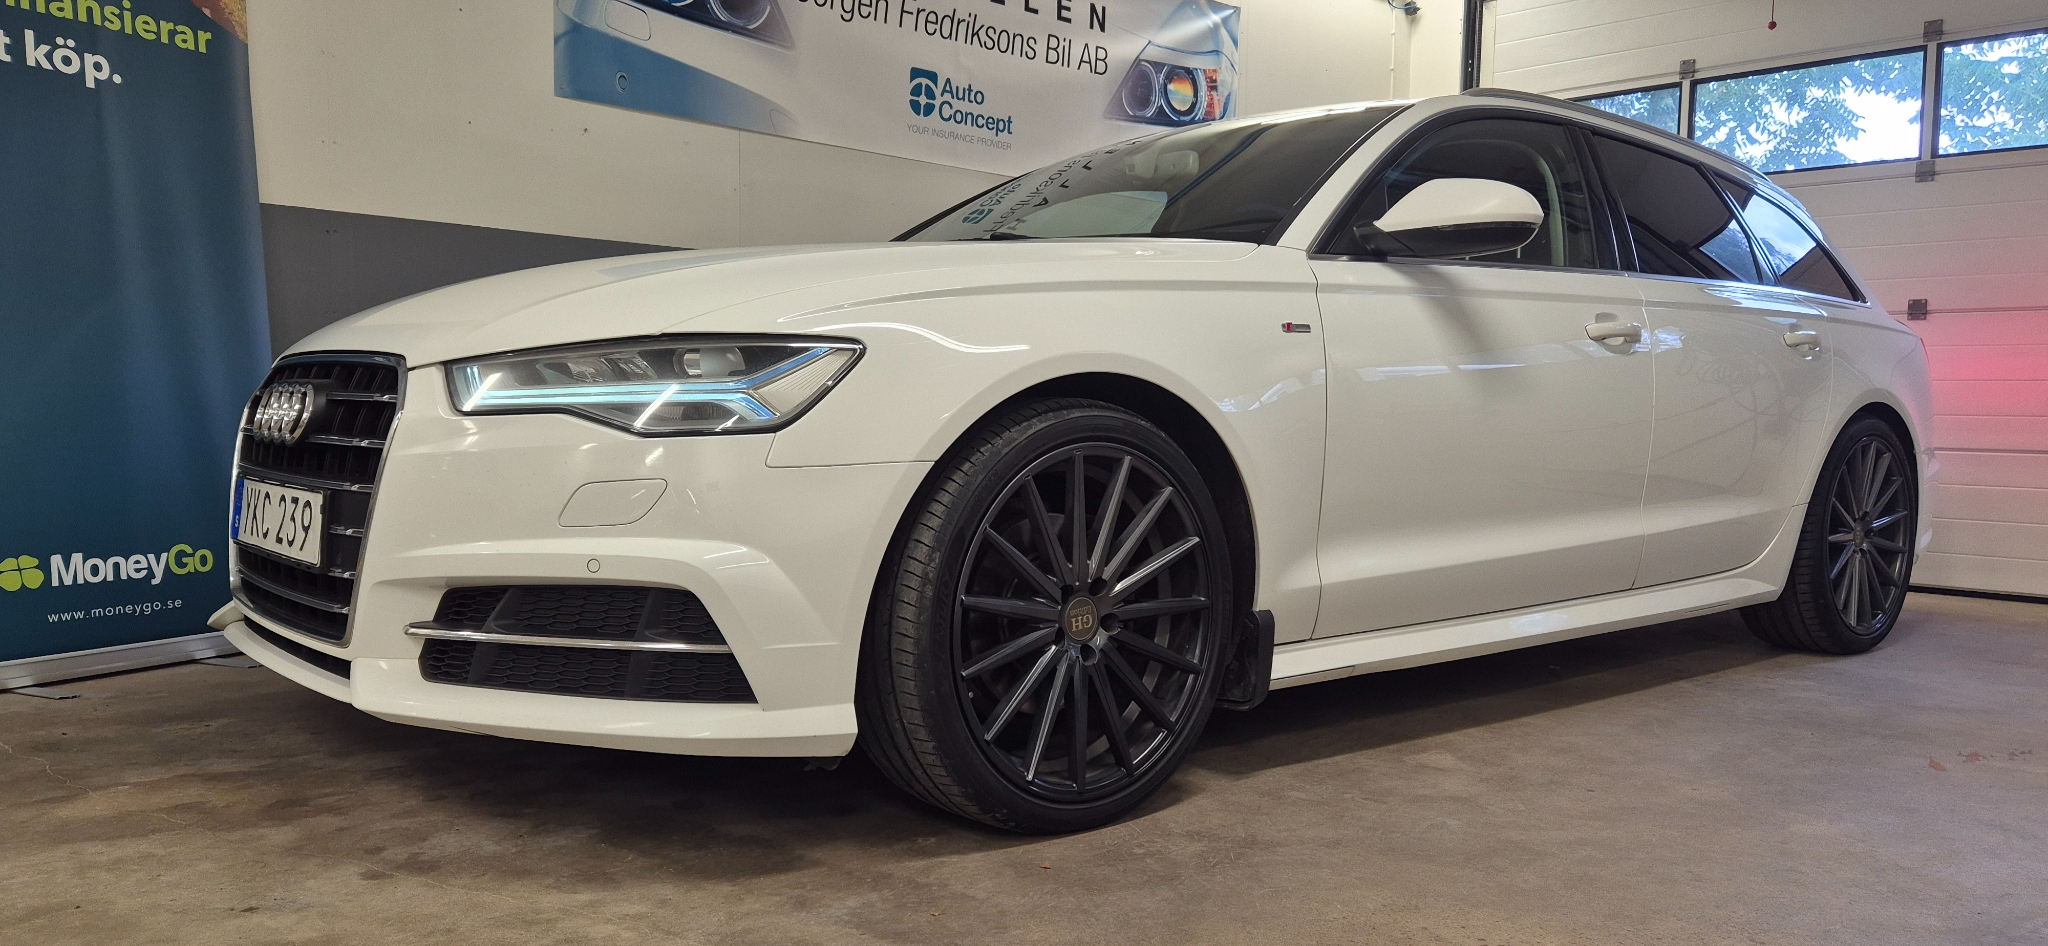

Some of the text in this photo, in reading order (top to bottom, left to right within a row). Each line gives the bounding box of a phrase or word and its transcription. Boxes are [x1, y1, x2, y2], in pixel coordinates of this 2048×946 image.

[898, 0, 1037, 60] Fredriksons
[1045, 34, 1072, 68] Bil
[1076, 43, 1108, 75] AB
[24, 29, 122, 88] köp.
[940, 77, 985, 105] Auto
[938, 100, 1013, 137] Concept
[906, 123, 1012, 151] YOUR INSURANCE PROVIDER
[234, 515, 240, 528] S
[243, 486, 313, 552] YKC 239
[50, 543, 214, 587] MoneyGo
[47, 598, 182, 624] www.moneygo.se
[1070, 614, 1093, 632] GH
